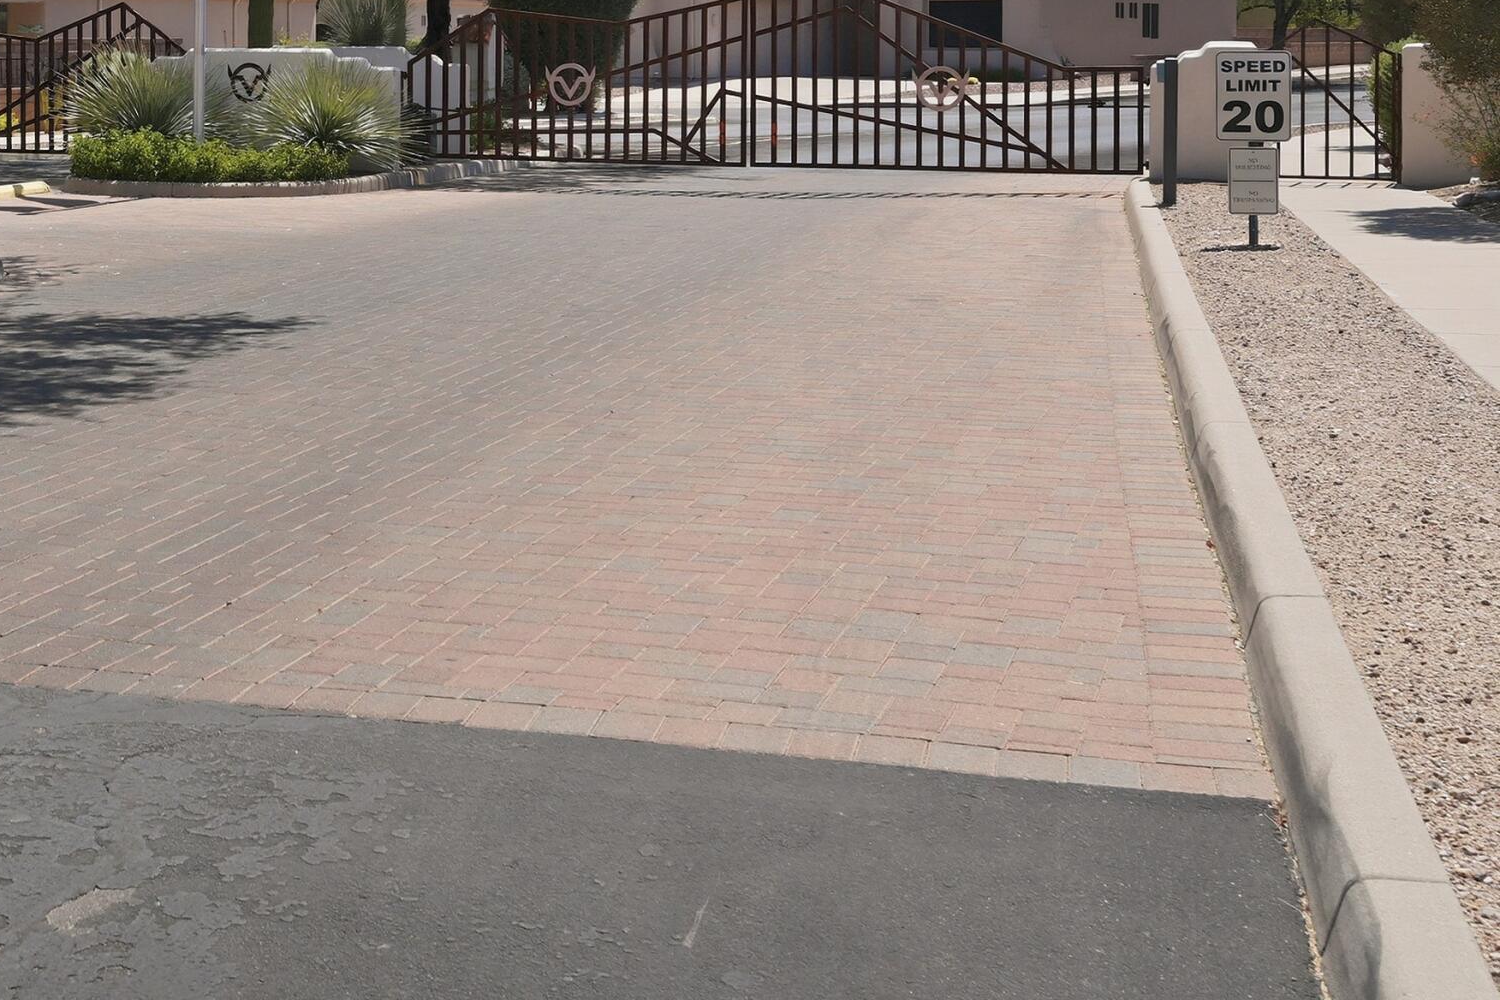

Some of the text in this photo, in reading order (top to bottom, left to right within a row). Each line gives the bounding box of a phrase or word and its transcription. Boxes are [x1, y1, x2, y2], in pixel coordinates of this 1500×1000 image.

[1220, 60, 1286, 73] SPEED
[1225, 79, 1281, 92] LIMIT
[1222, 100, 1284, 133] 20
